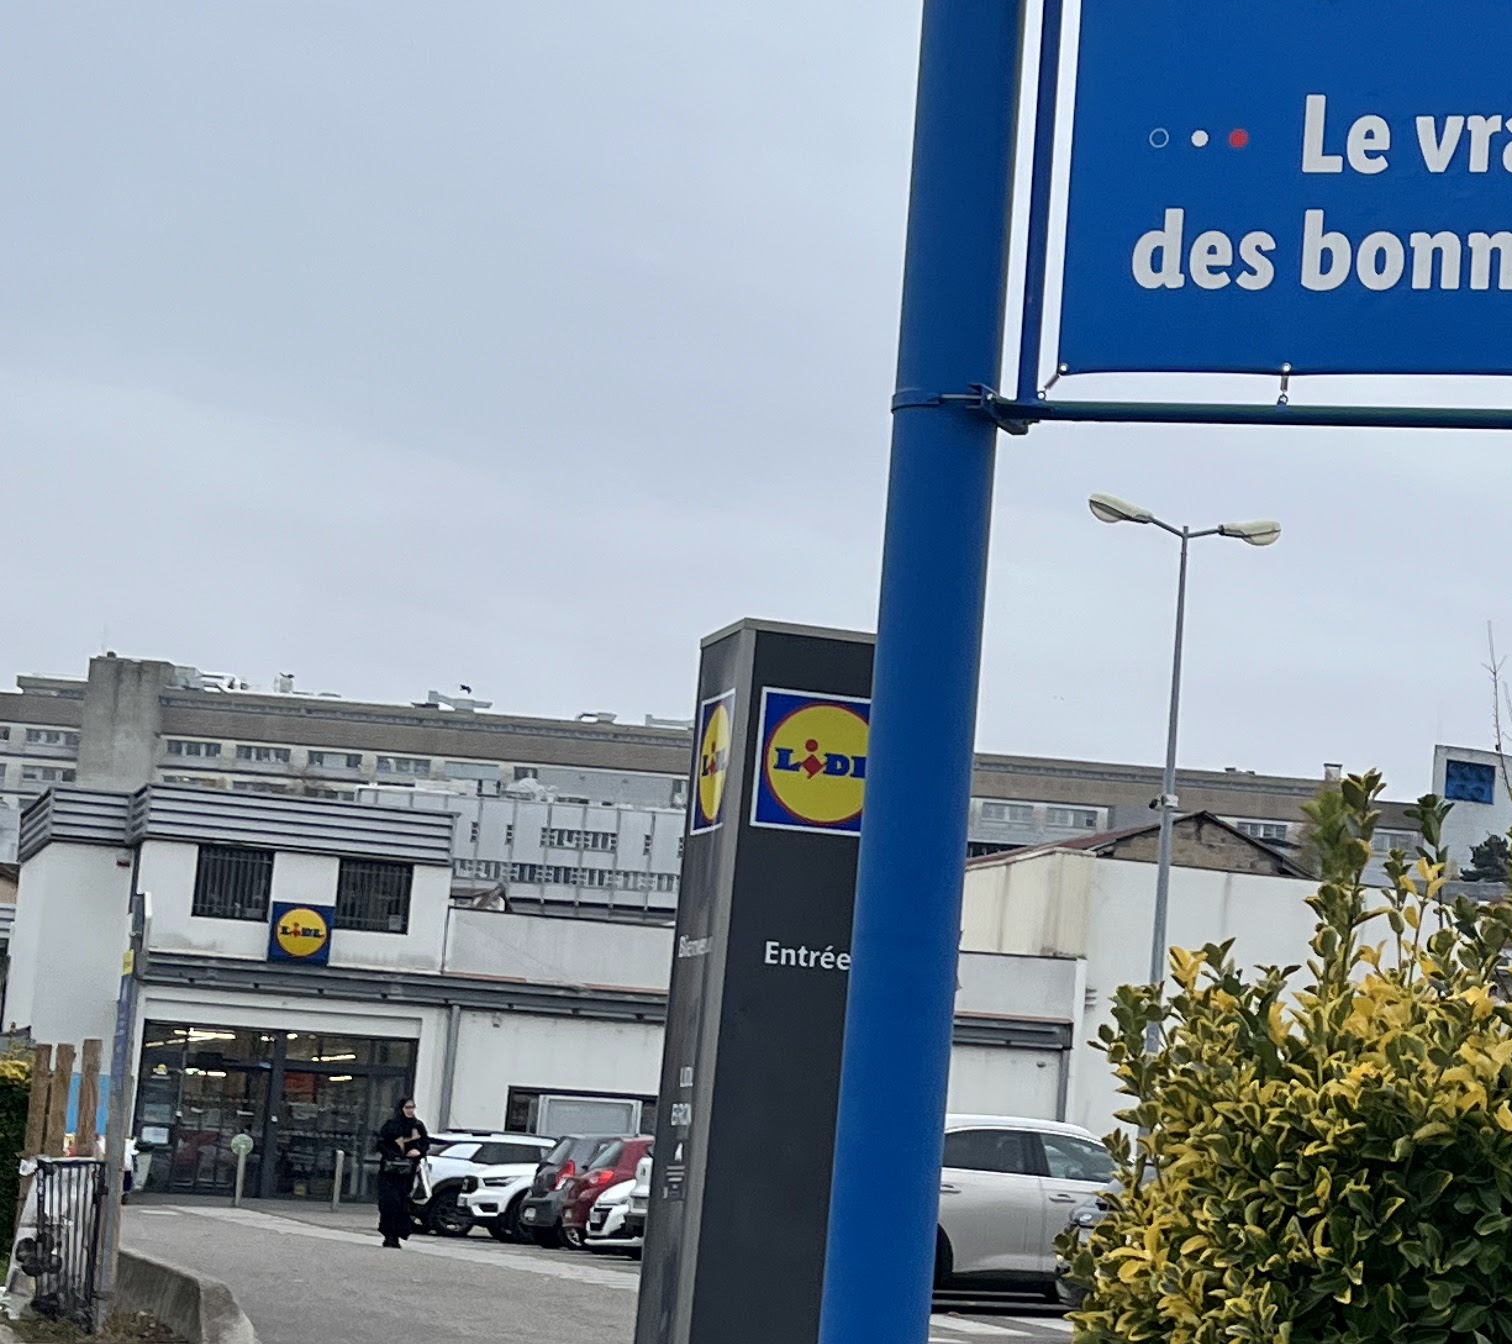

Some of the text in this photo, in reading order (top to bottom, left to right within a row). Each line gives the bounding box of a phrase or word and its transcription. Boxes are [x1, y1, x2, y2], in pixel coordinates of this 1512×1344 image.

[1301, 94, 1390, 174] Le
[1132, 208, 1275, 290] des
[764, 940, 851, 971] Entrée
